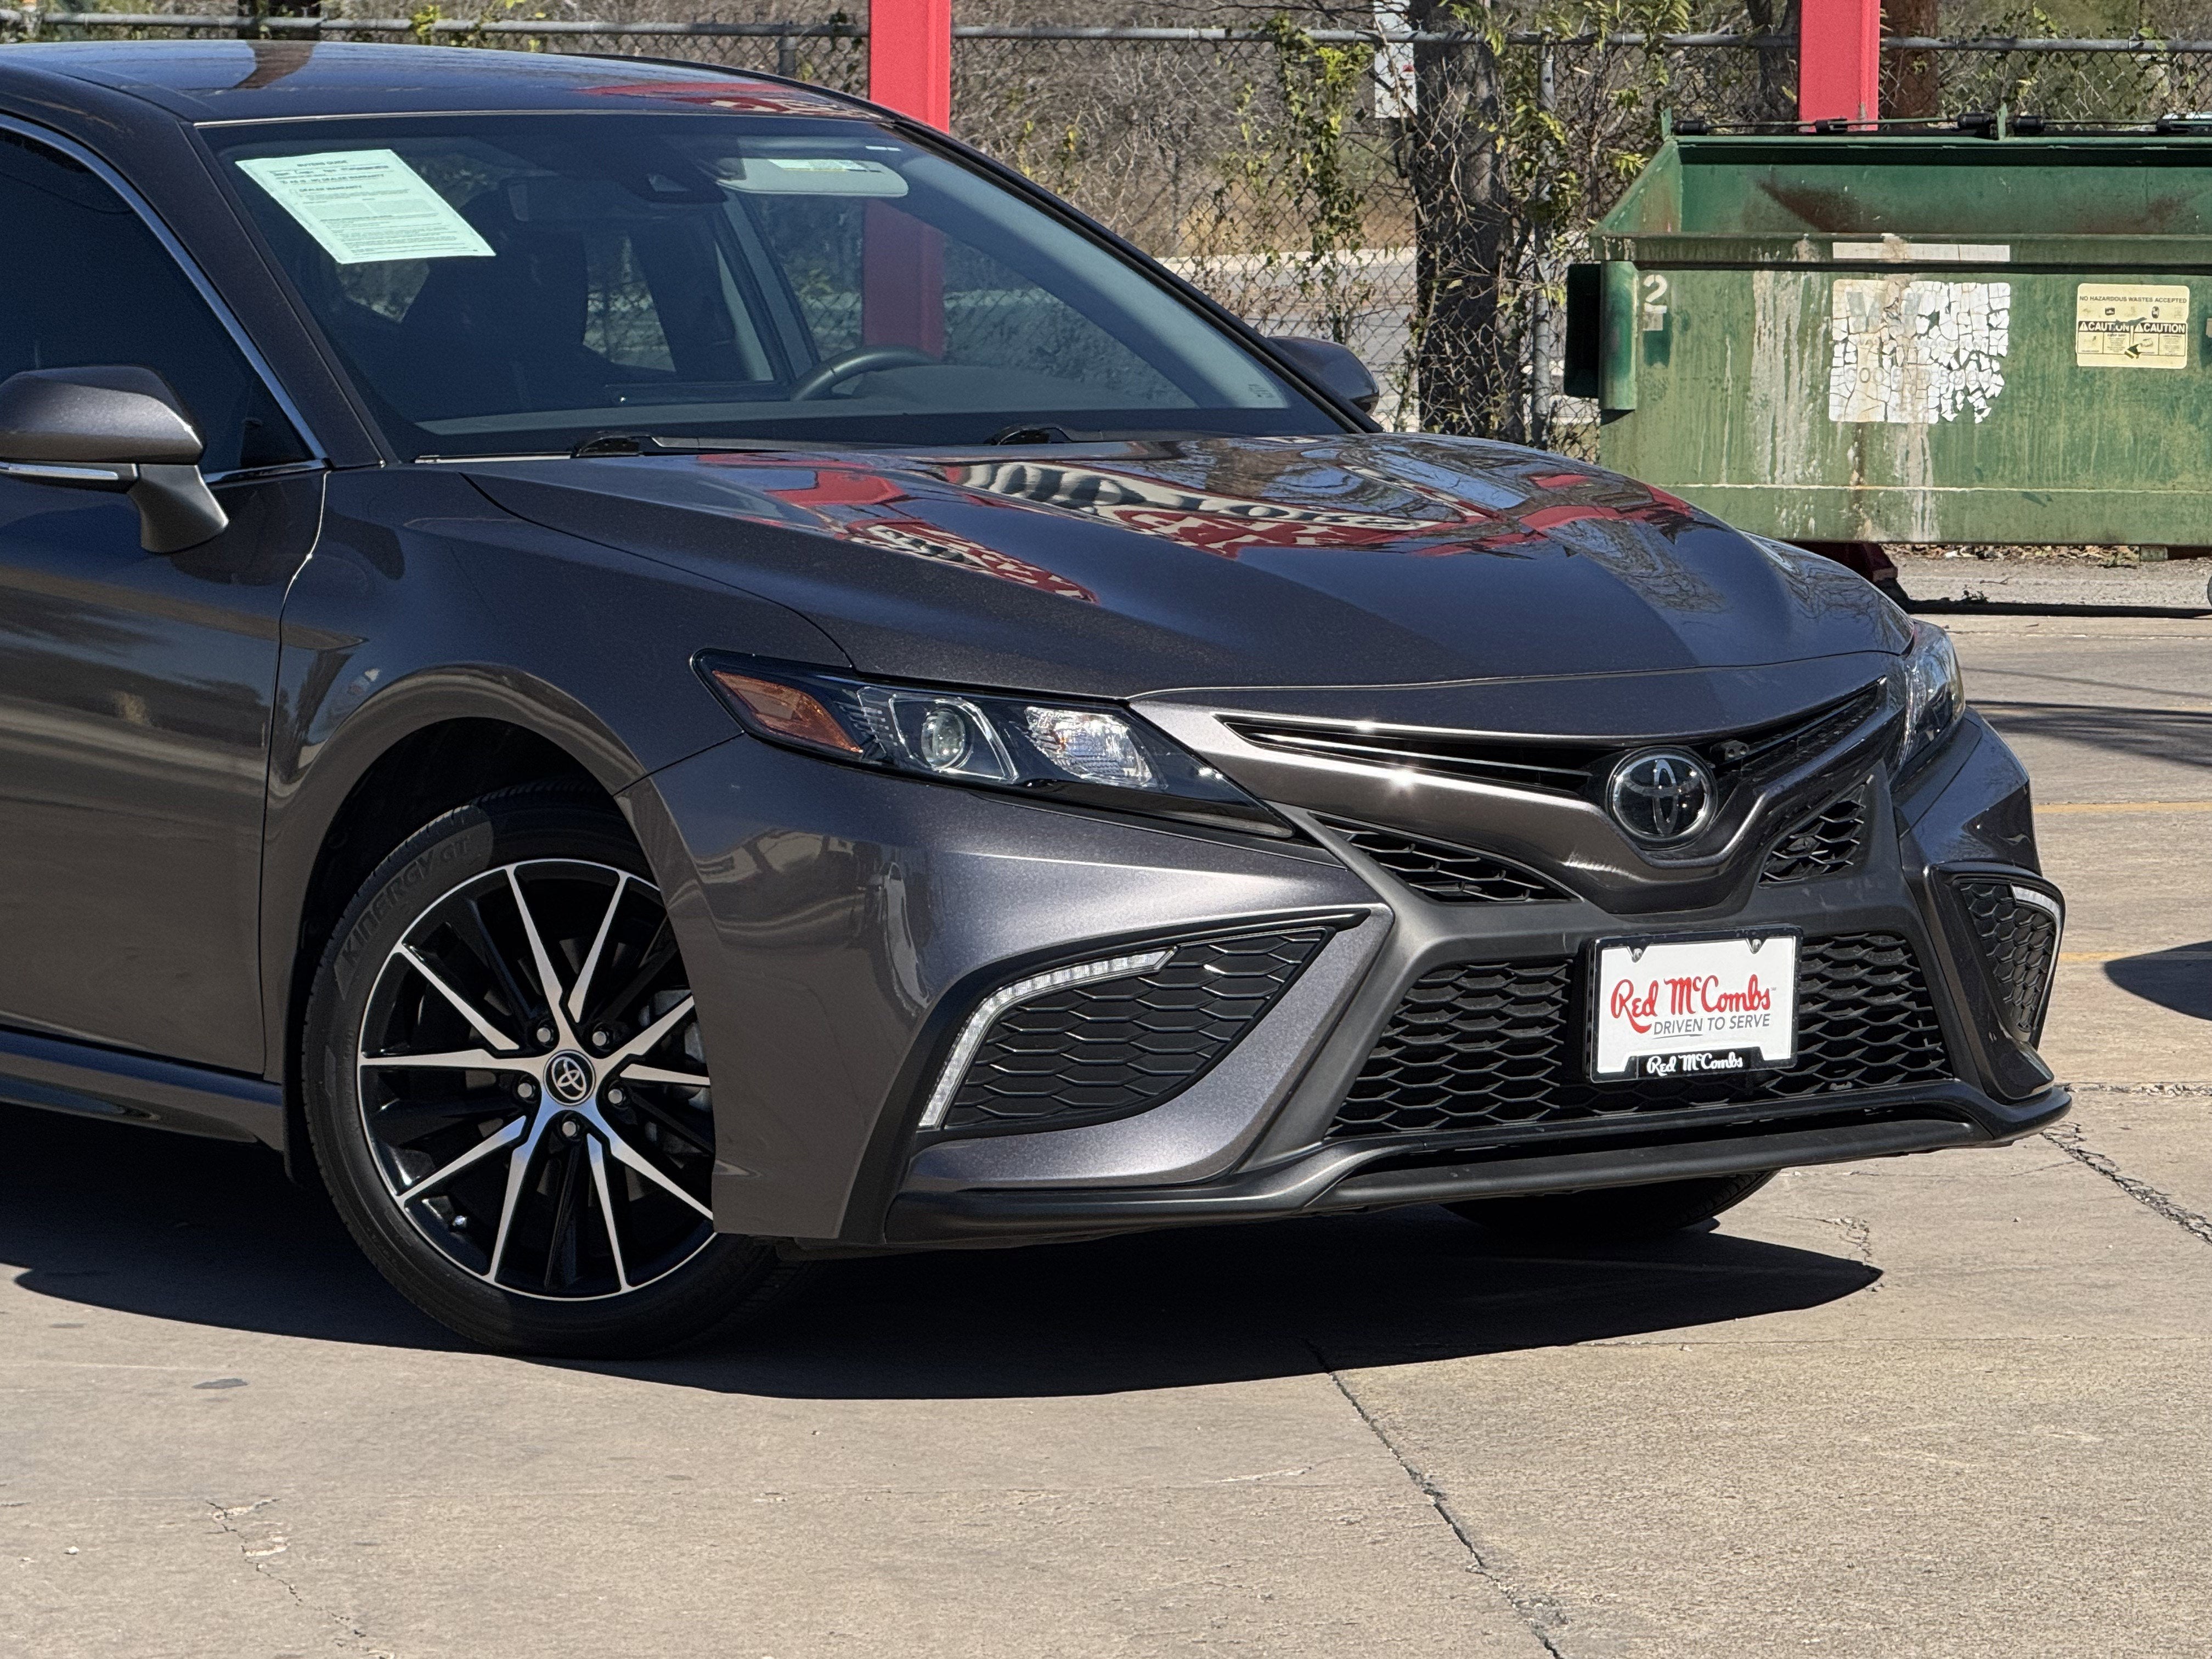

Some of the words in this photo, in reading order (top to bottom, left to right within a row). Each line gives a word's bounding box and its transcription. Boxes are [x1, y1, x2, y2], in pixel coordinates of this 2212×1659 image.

[1643, 274, 1667, 314] 2
[2143, 323, 2186, 333] CAUTION
[1611, 979, 1658, 1034] Red
[1663, 974, 1771, 1015] McCombs
[1654, 1018, 1703, 1035] DRIVEN
[1707, 1016, 1725, 1031] TO
[1729, 1013, 1770, 1030] SERVE
[1647, 1054, 1677, 1076] Red
